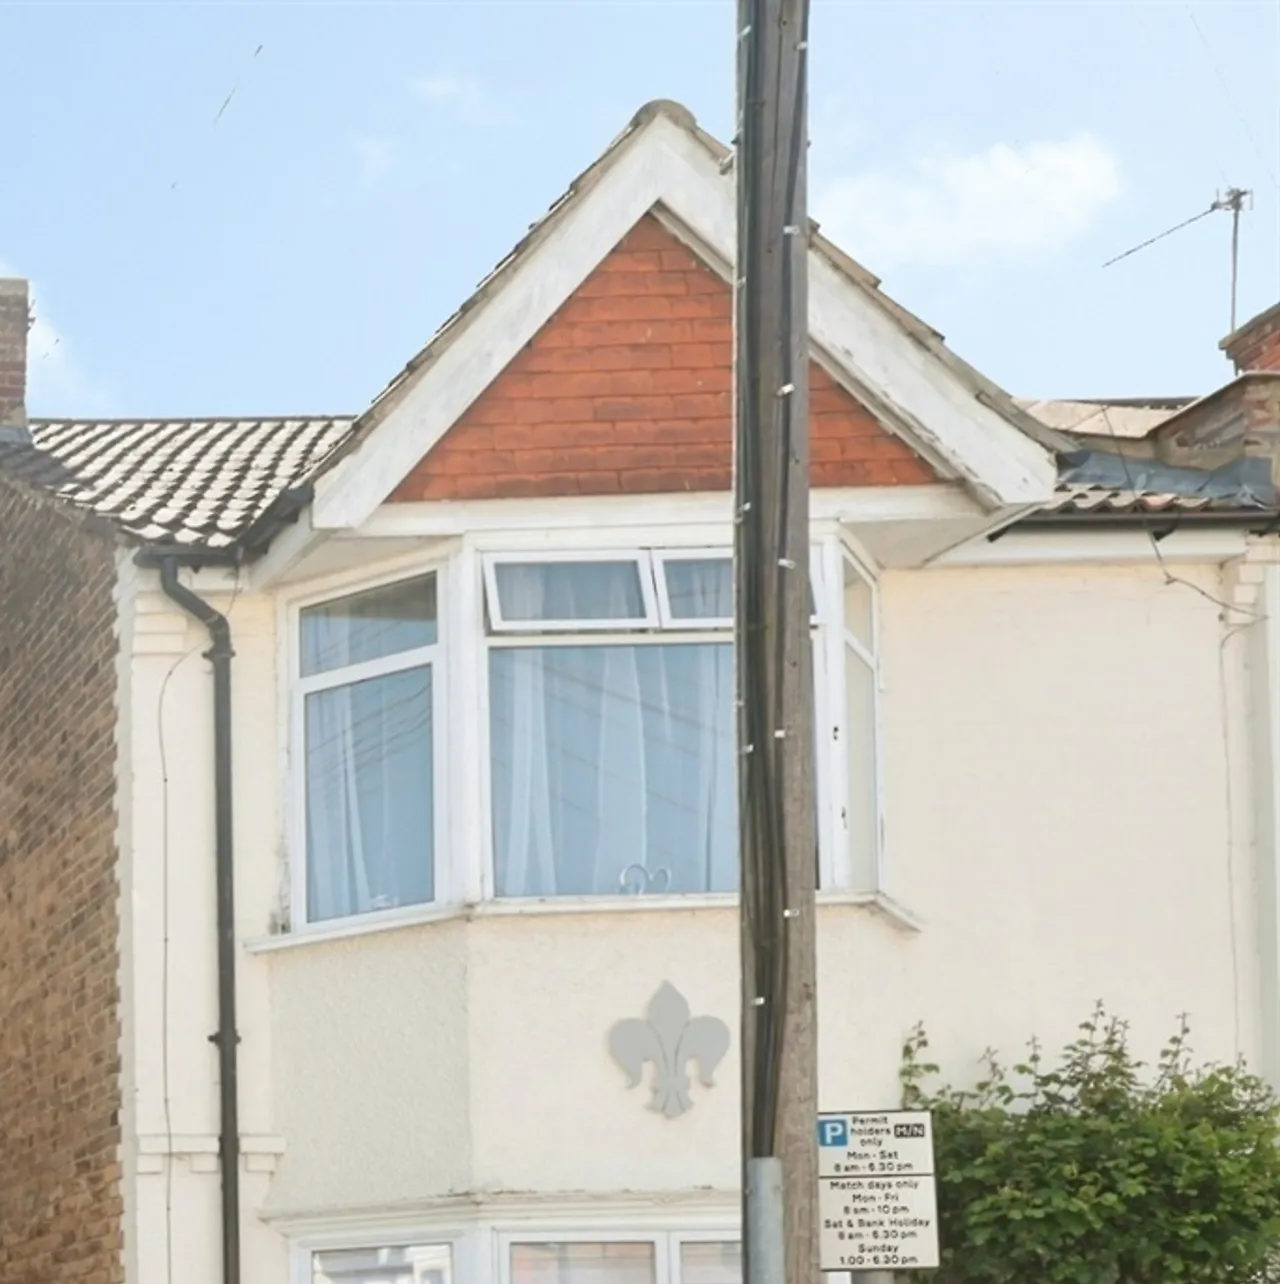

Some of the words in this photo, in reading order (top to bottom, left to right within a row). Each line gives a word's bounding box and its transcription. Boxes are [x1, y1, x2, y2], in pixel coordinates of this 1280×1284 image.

[852, 1116, 888, 1125] Permit
[824, 1122, 844, 1145] P
[850, 1127, 891, 1135] holders
[860, 1137, 883, 1147] only
[847, 1151, 870, 1160] Mon
[879, 1150, 899, 1159] Sat
[844, 1164, 860, 1172] am
[868, 1162, 895, 1172] 6.30
[897, 1163, 914, 1171] pm
[830, 1181, 864, 1190] Match
[867, 1181, 893, 1190] days
[895, 1180, 919, 1190] only
[852, 1193, 876, 1203] Mon
[884, 1192, 899, 1201] Fri
[877, 1204, 890, 1214] 10
[892, 1205, 910, 1215] pm
[824, 1219, 843, 1229] Sat
[847, 1219, 854, 1228] &
[858, 1219, 884, 1227] Bank
[889, 1218, 930, 1227] Holiday
[848, 1232, 864, 1240] am
[872, 1230, 899, 1239] 6.30
[900, 1231, 918, 1240] pm
[858, 1243, 899, 1253] Sunday
[840, 1255, 865, 1265] 1.00
[872, 1255, 899, 1265] 6.30
[901, 1256, 919, 1265] pm
